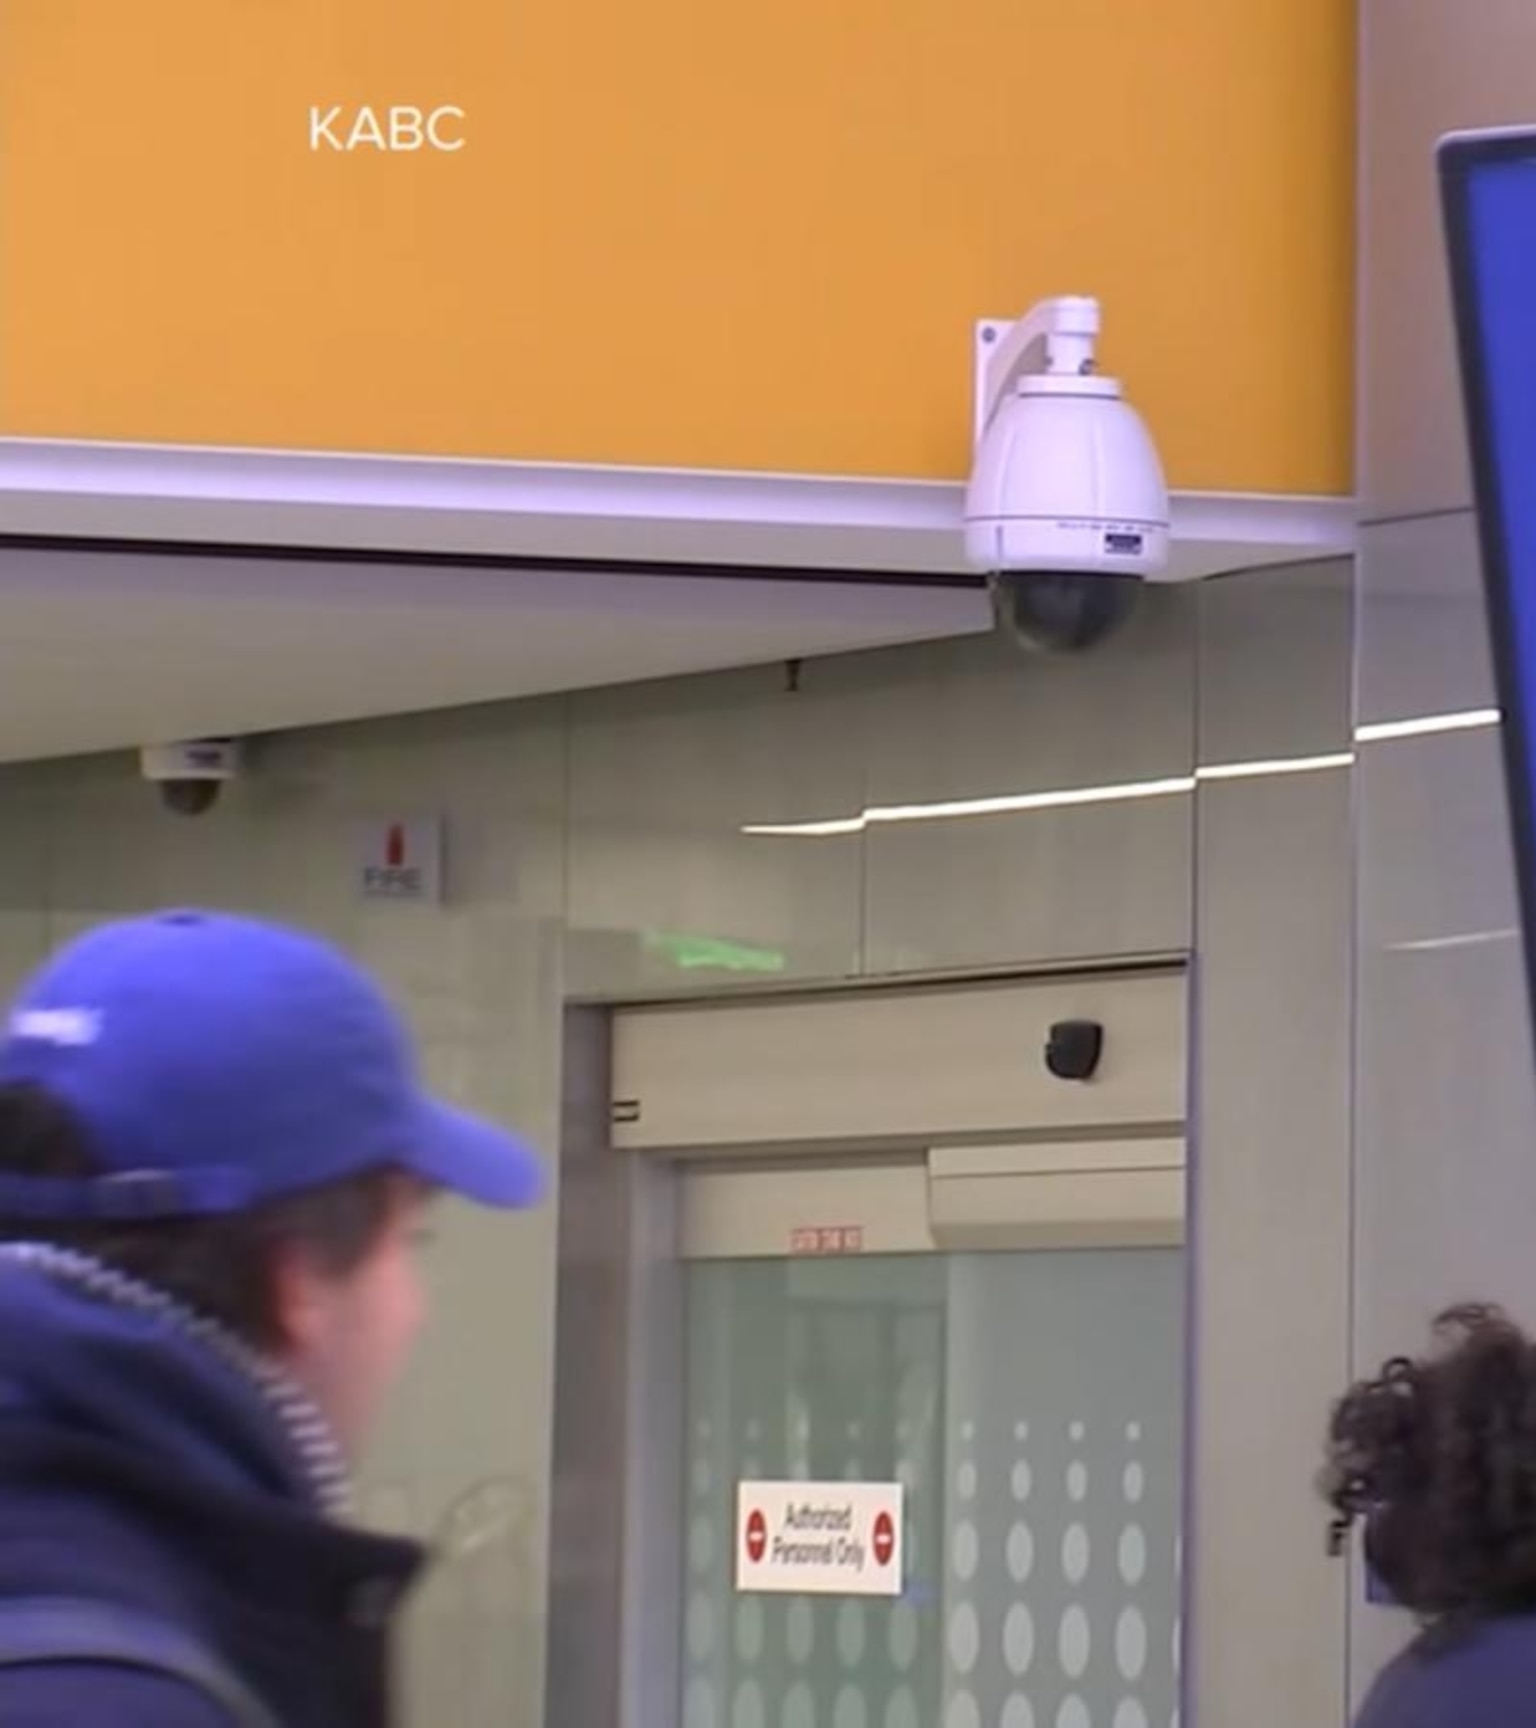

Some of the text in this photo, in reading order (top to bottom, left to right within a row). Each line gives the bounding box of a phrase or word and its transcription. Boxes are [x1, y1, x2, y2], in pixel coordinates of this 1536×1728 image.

[363, 866, 422, 890] FIRE
[784, 1502, 853, 1532] Authorized
[770, 1535, 866, 1574] Personnel Only
